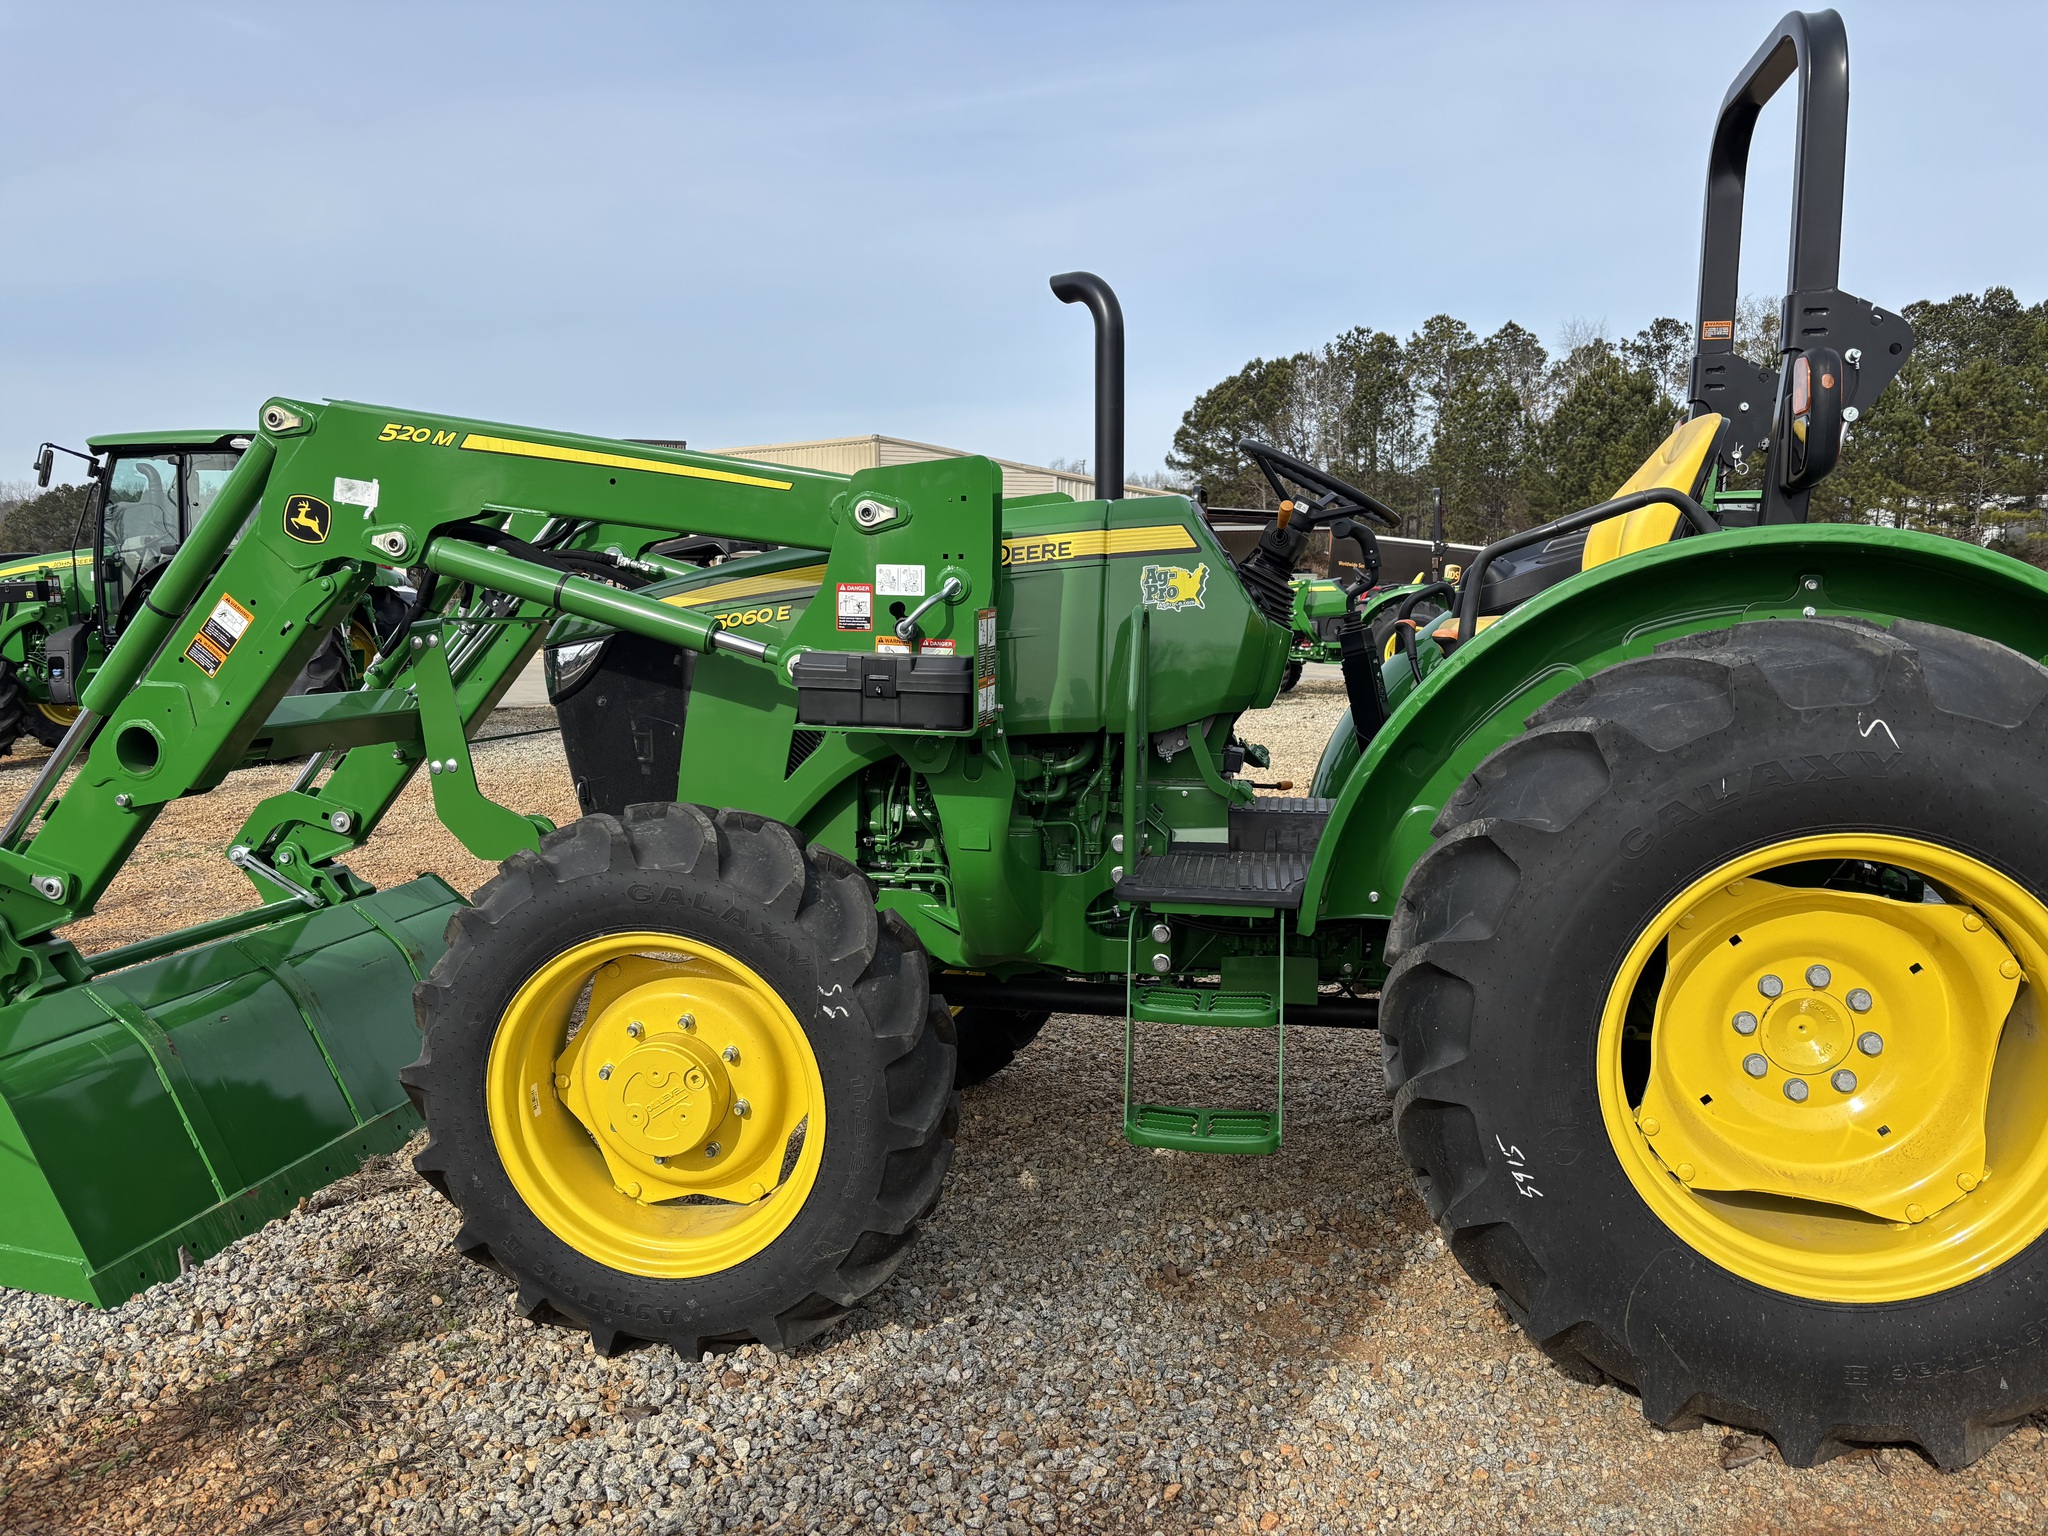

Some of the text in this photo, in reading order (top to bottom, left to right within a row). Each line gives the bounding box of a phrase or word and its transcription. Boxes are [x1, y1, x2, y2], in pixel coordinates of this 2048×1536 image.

[377, 423, 458, 447] 520 M
[76, 557, 94, 565] DEER
[1002, 541, 1072, 563] DEERE
[1144, 568, 1177, 587] Ag-
[1145, 585, 1179, 601] Pro
[230, 599, 251, 619] WARNING
[714, 605, 793, 631] 5060 E
[203, 640, 223, 660] WARNING
[1618, 750, 1907, 861] GALAXY
[626, 884, 813, 969] GALAXY
[532, 1259, 690, 1325] AgriTrac
